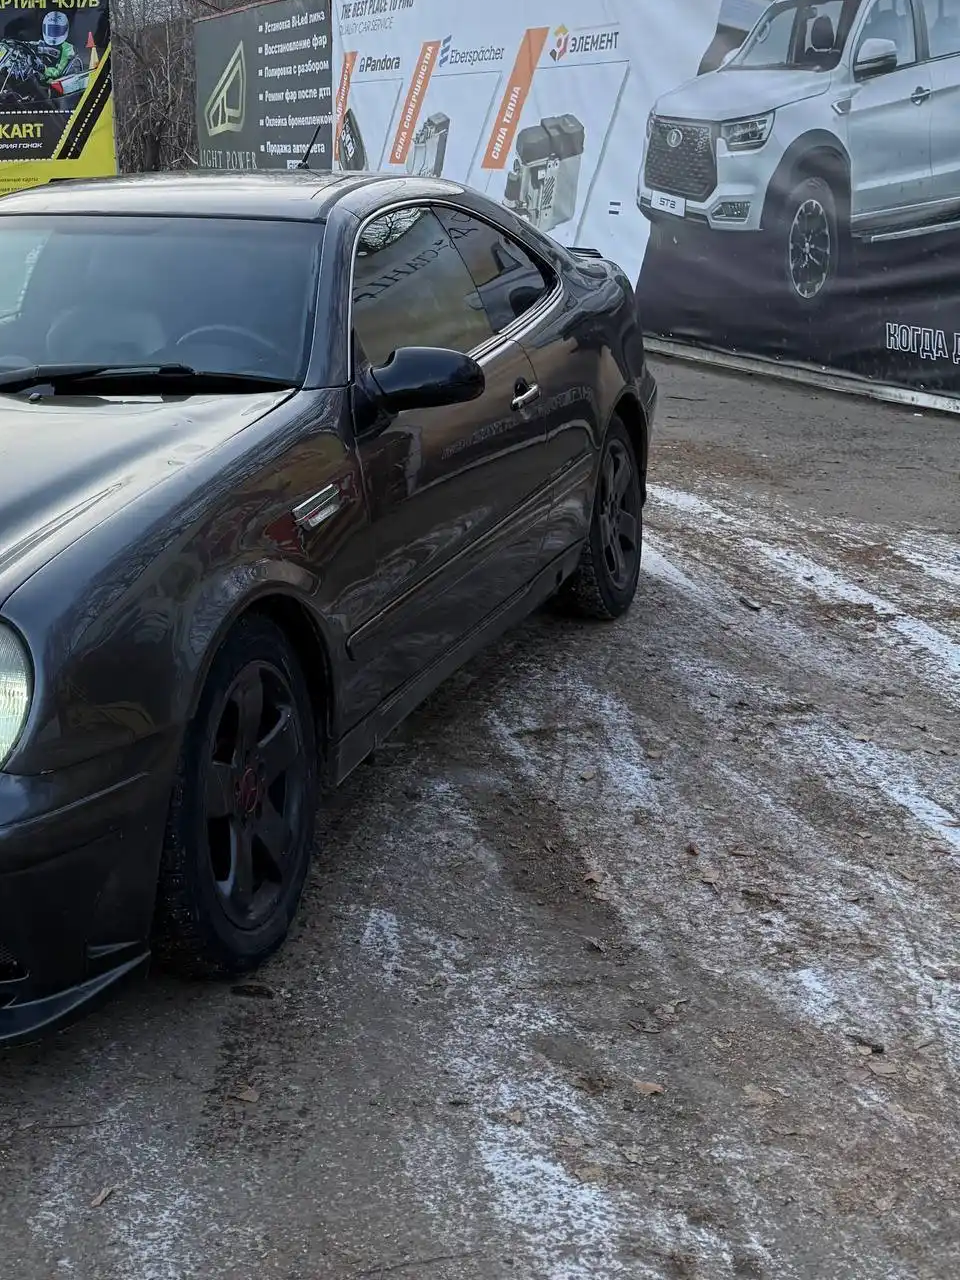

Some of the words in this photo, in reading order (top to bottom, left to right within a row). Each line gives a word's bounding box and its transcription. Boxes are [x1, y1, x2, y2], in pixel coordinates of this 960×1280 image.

[341, 3, 352, 19] THE
[352, 0, 368, 18] BEST
[264, 39, 311, 56] Восстановление
[311, 34, 327, 49] фар
[569, 31, 620, 53] ЭЛЕМЕНТ
[297, 59, 330, 77] разбором
[364, 54, 401, 72] Pandora
[284, 88, 297, 103] фар
[297, 88, 317, 99] после
[266, 141, 291, 156] Продажа
[200, 149, 223, 169] LIGHT
[226, 150, 258, 170] POWER
[886, 322, 949, 361] КОГДА
